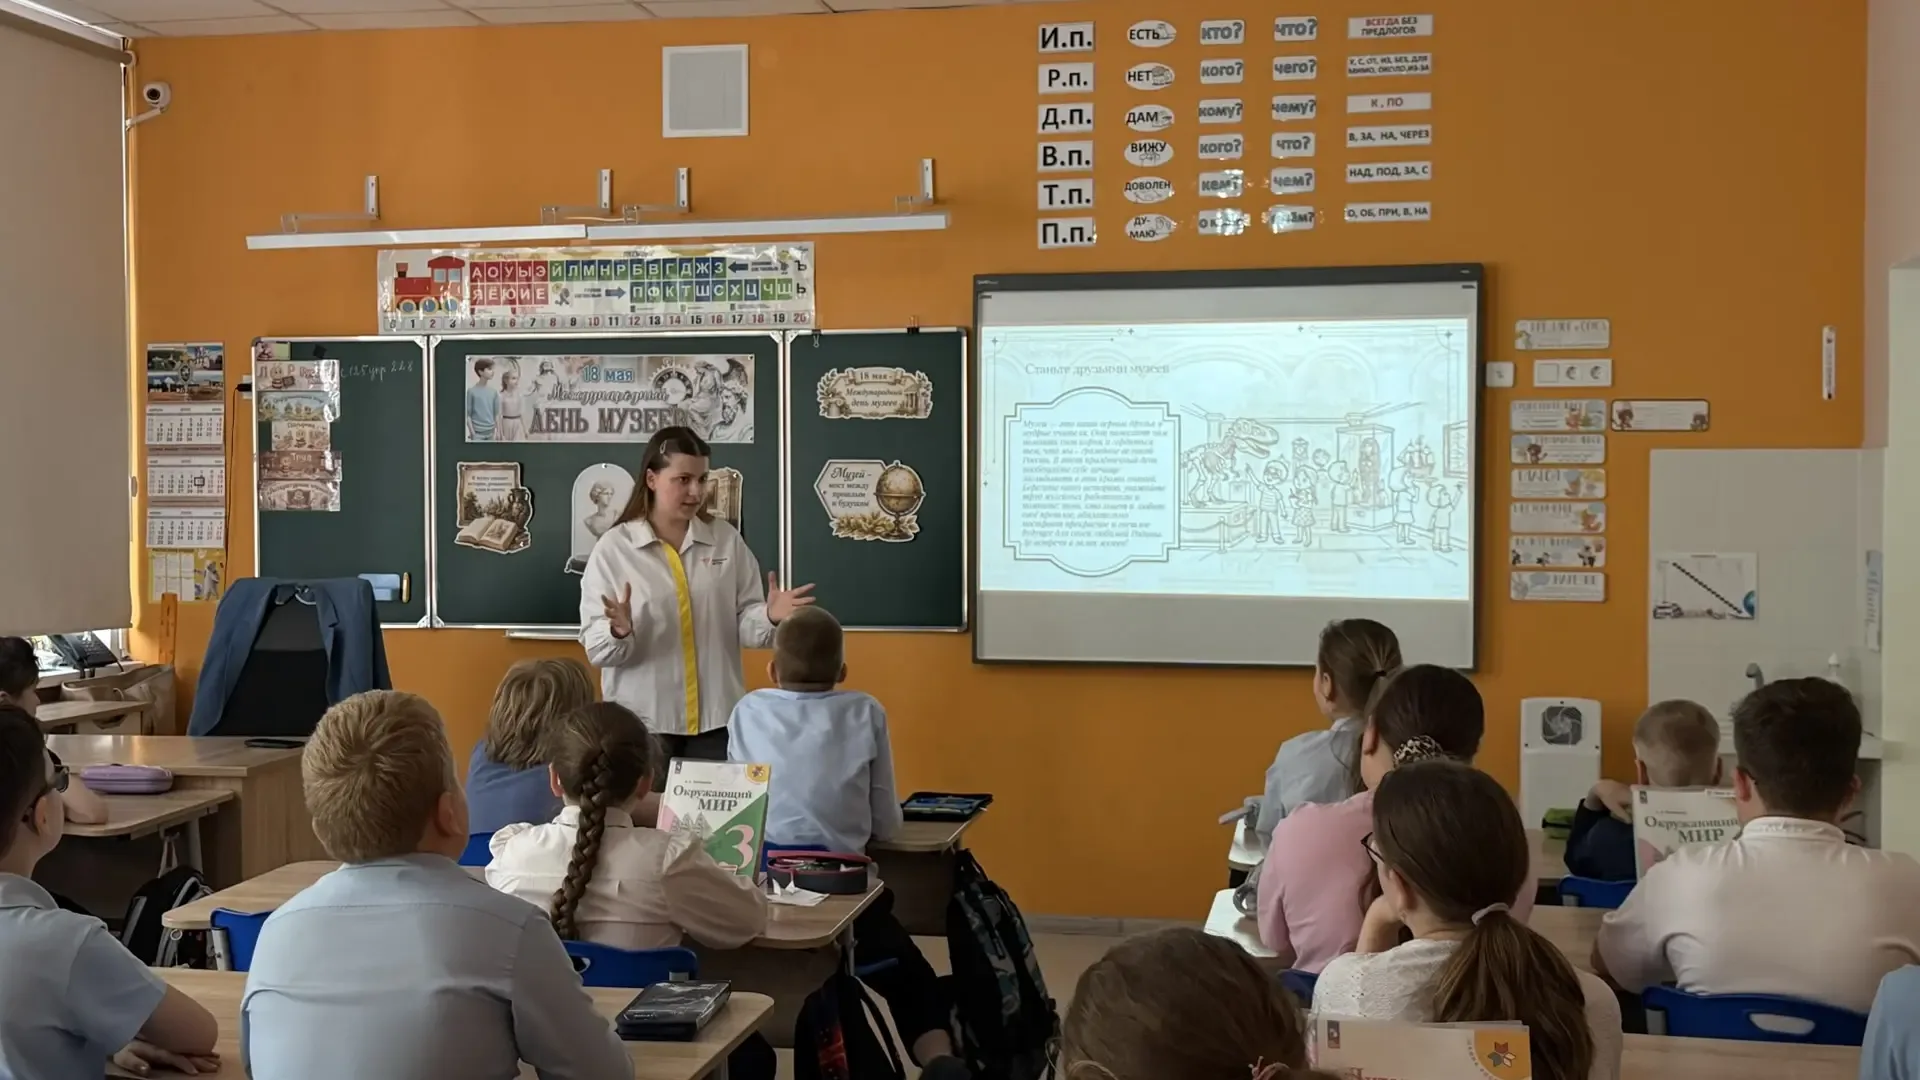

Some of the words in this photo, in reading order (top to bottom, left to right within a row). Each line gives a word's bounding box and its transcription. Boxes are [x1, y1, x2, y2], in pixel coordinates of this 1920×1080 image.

[1275, 18, 1317, 36] что?
[1365, 18, 1399, 26] ВСЕГДА
[1401, 17, 1417, 25] БЕЗ
[1041, 27, 1092, 48] И.п.
[1129, 29, 1160, 40] ЕСТЬ
[1202, 22, 1243, 40] кто?
[1361, 26, 1417, 36] ПРЕДЛОГОВ
[1202, 62, 1243, 76] кого?
[1275, 59, 1316, 74] чего?
[1048, 69, 1088, 87] Р.п.
[1128, 70, 1152, 82] НЕТ
[1272, 99, 1316, 115] чему?
[1387, 98, 1404, 106] ПО
[1125, 111, 1158, 125] ДАМ
[1199, 103, 1243, 119] кому?
[1042, 108, 1091, 130] Д.п.
[1360, 132, 1376, 141] ЗА,
[1380, 132, 1397, 141] НА,
[1400, 130, 1429, 139] ЧЕРЕЗ
[1131, 142, 1167, 153] ВИЖУ
[1200, 139, 1241, 153] кого?
[1276, 136, 1311, 150] что?
[1043, 146, 1091, 167] В.п.
[1349, 168, 1373, 177] НАД,
[1376, 167, 1401, 177] ПОД,
[1404, 166, 1419, 175] ЗА,
[1422, 165, 1429, 174] С
[1124, 181, 1171, 192] ДОВОЛЕН
[1273, 173, 1313, 187] чем?
[1043, 184, 1091, 205] Т.п.
[1360, 209, 1376, 218] ОБ,
[1378, 208, 1401, 217] ПРИ,
[1414, 207, 1428, 215] НА
[1133, 217, 1150, 226] ДУ-
[1042, 223, 1093, 244] П.п.
[411, 319, 415, 328] 1
[430, 319, 436, 328] 2
[450, 319, 456, 328] 3
[469, 319, 475, 328] 4
[489, 318, 496, 328] 5
[509, 318, 516, 328] 6
[530, 318, 536, 327] 7
[550, 318, 557, 327] 8
[570, 317, 577, 326] 9
[588, 317, 600, 326] 10
[608, 317, 619, 326] 11
[629, 317, 641, 326] 12
[649, 316, 661, 326] 13
[669, 315, 681, 325] 14
[691, 315, 702, 324] 15
[711, 315, 723, 324] 16
[732, 314, 743, 324] 17
[752, 314, 764, 323] 18
[773, 313, 785, 323] 19
[793, 313, 807, 323] 20
[583, 365, 599, 383] 18
[604, 368, 635, 383] мая
[1025, 363, 1070, 374] Станьте
[860, 372, 869, 380] 18
[548, 384, 669, 405] Международный
[845, 388, 903, 398] Международный
[852, 398, 869, 406] день
[871, 400, 898, 408] музеев
[529, 407, 589, 435] ДЕНЬ
[598, 407, 688, 434] МУЗЕЕВ
[830, 467, 865, 482] Музей
[673, 785, 752, 799] Окружающий
[698, 799, 738, 811] МИР
[1679, 828, 1724, 843] МИР
[725, 824, 754, 869] 3
